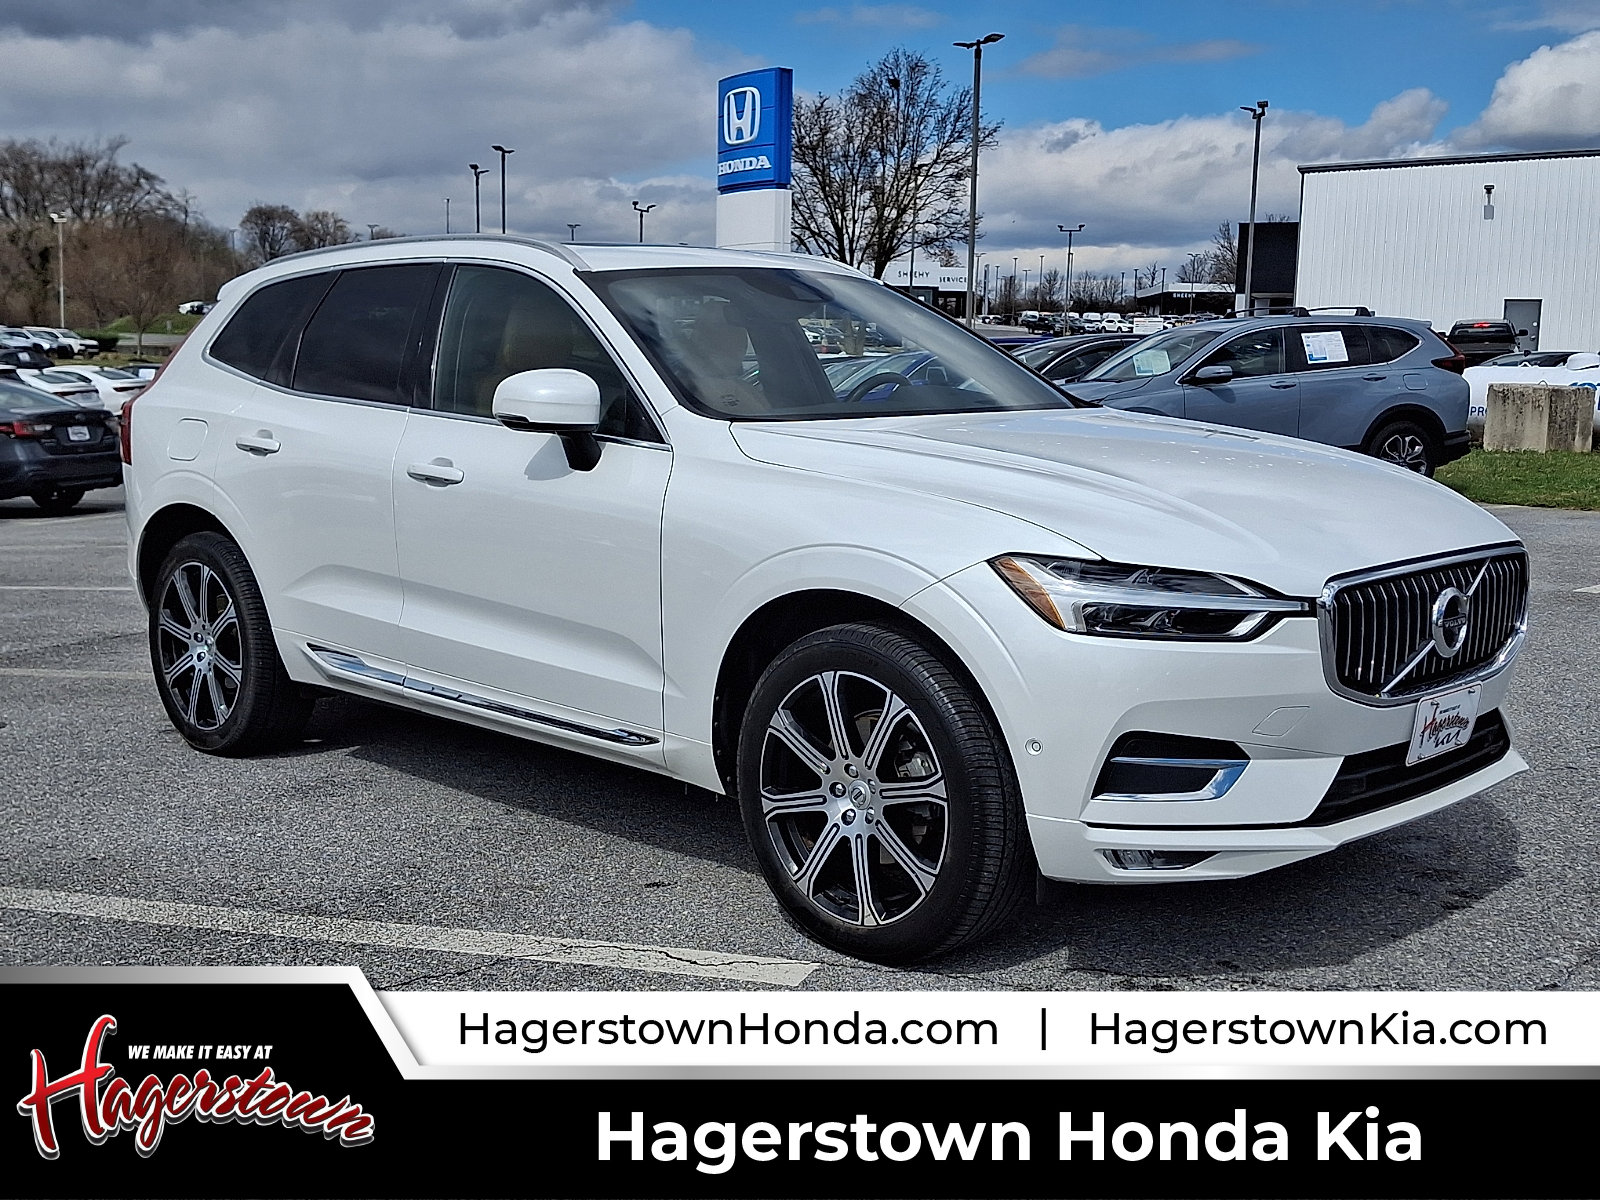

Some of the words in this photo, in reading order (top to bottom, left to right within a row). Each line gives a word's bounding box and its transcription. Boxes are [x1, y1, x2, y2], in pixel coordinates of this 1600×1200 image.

[718, 155, 772, 175] HONDA
[898, 270, 930, 278] SHEHY
[1444, 617, 1466, 628] VOLVO
